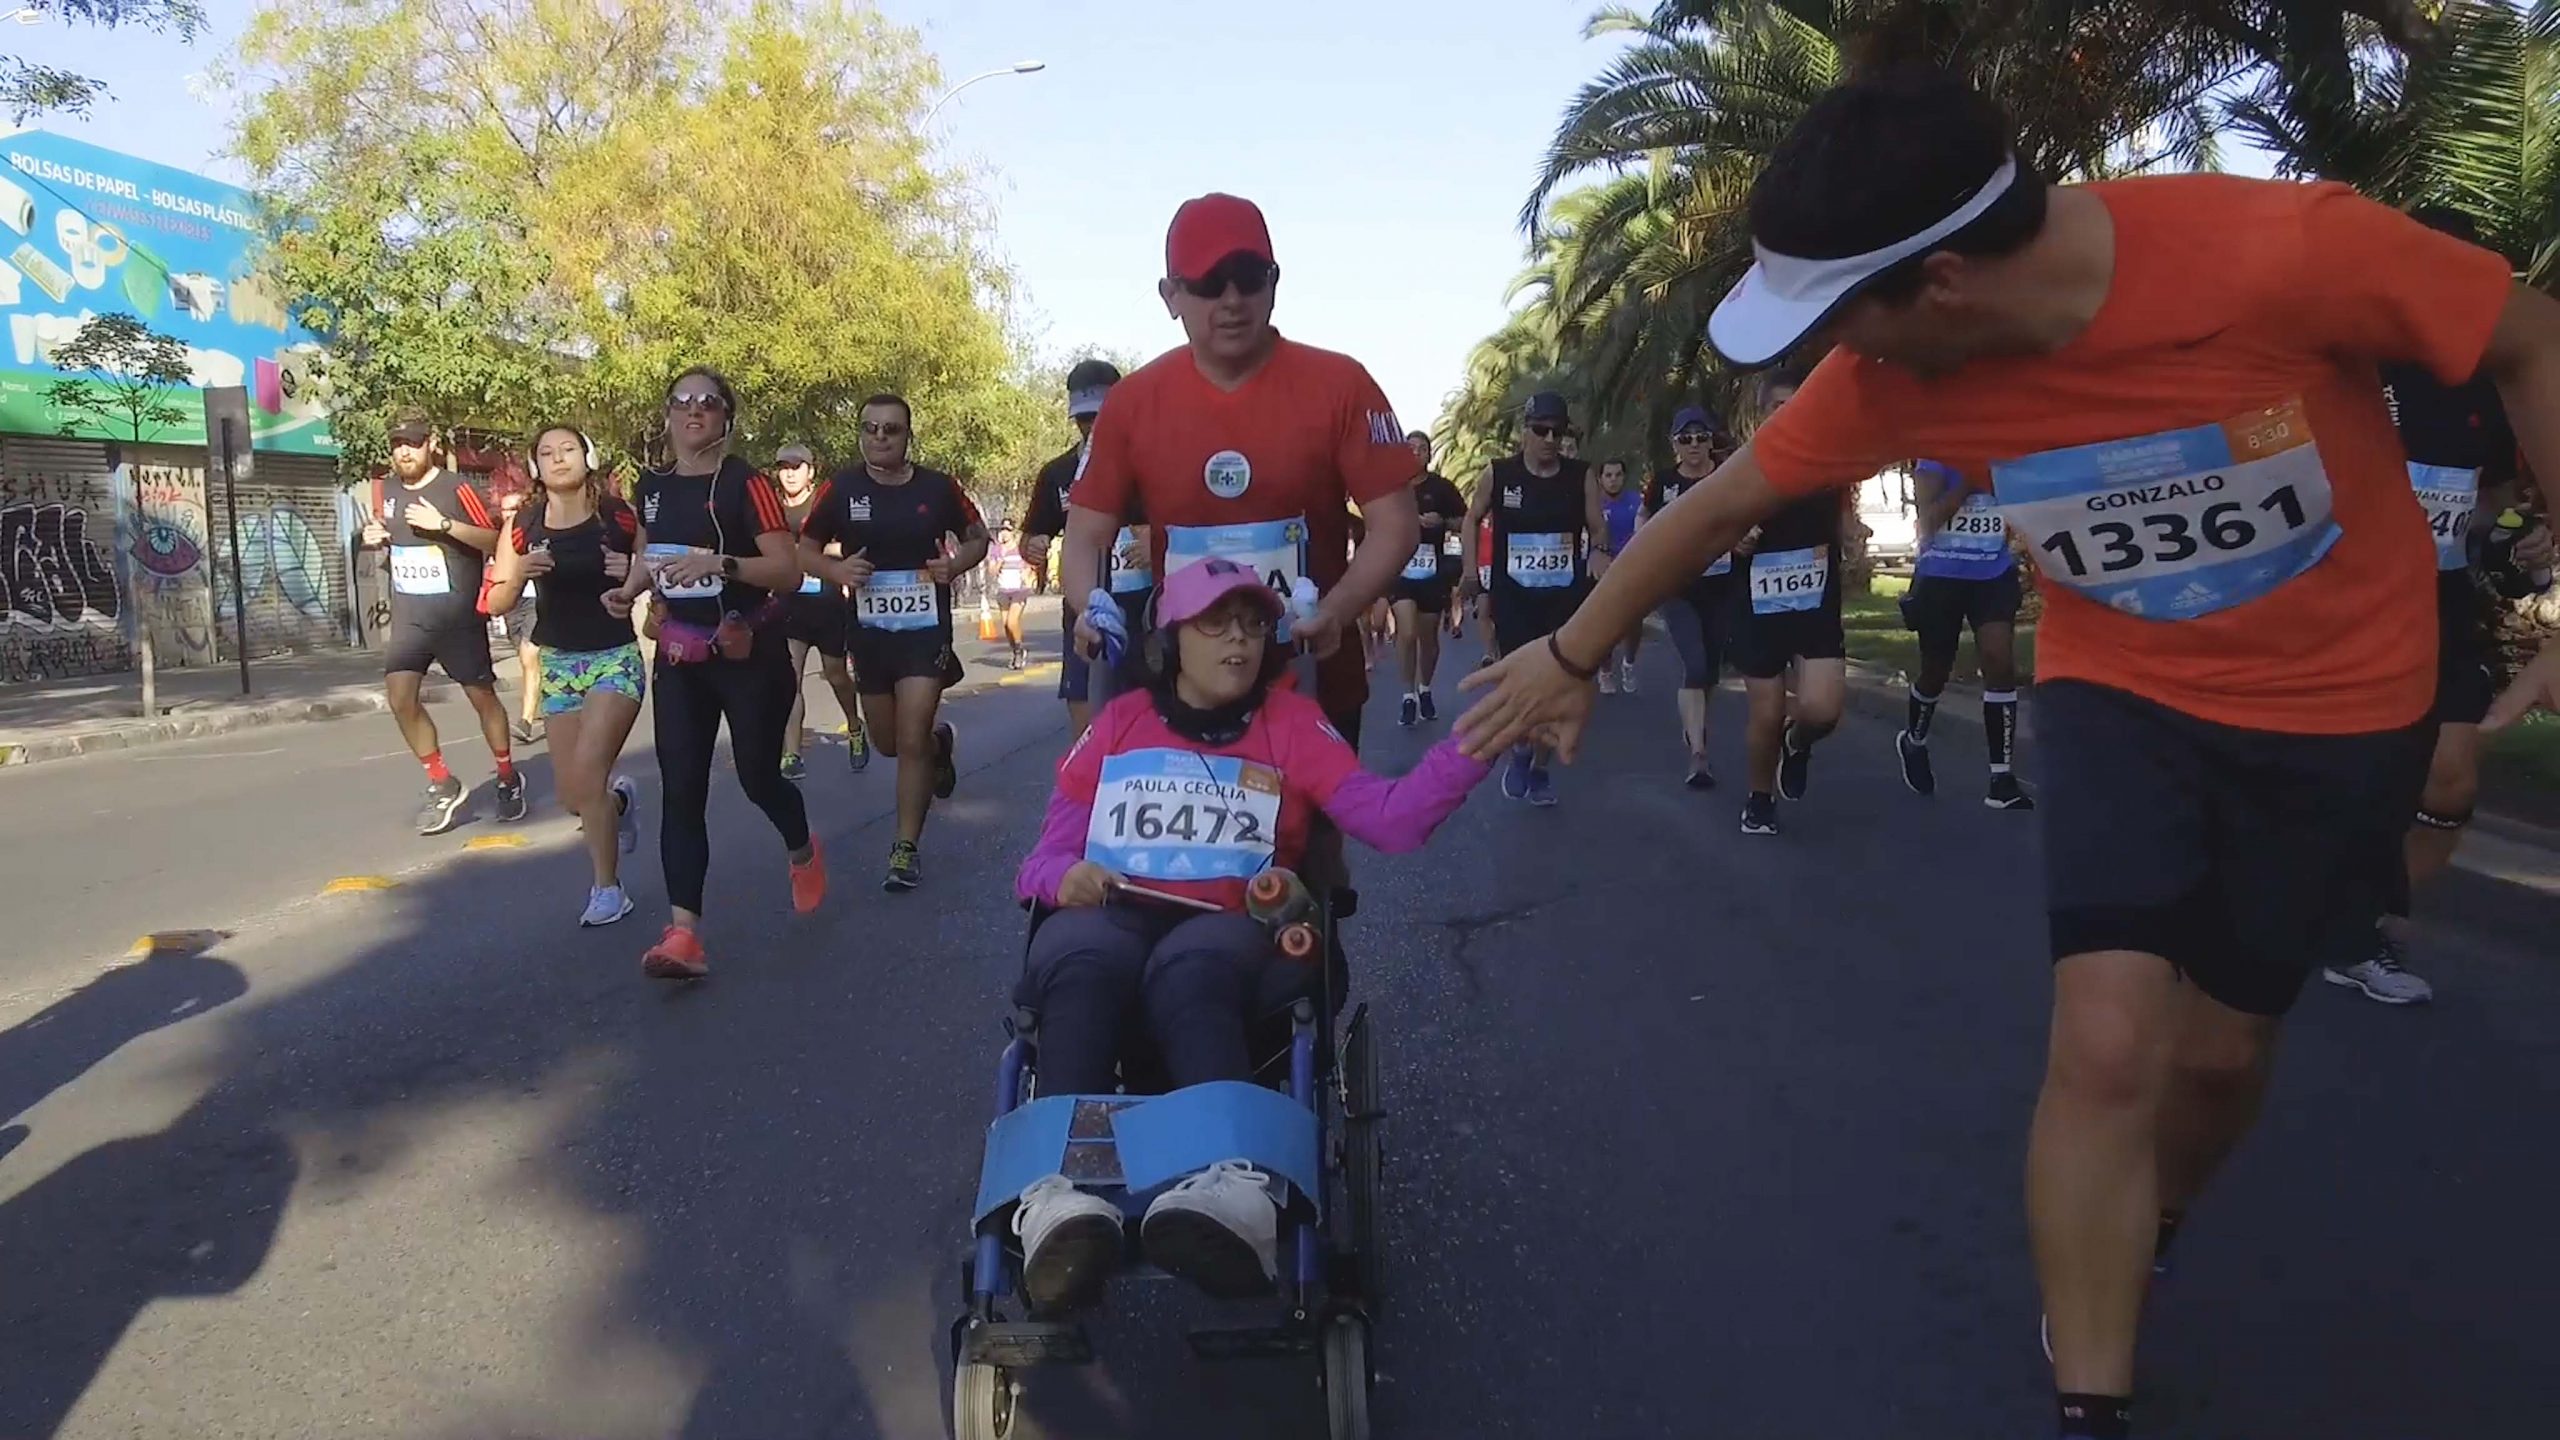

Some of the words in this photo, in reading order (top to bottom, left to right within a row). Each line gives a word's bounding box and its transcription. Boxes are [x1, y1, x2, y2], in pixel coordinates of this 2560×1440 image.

[10, 152, 72, 184] BOLSAS
[74, 169, 95, 191] DE
[96, 174, 140, 202] PAPEL
[152, 189, 201, 217] BOLSAS
[2087, 475, 2225, 511] GONZALO
[1946, 516, 2002, 533] 12838
[2042, 485, 2306, 576] 13361
[394, 565, 441, 579] 12208
[1515, 554, 1569, 570] 12439
[1758, 570, 1825, 594] 11647
[864, 594, 931, 614] 13025
[1124, 780, 1177, 793] PAULA
[1184, 780, 1247, 802] CECILIA
[1109, 801, 1262, 844] 16472
